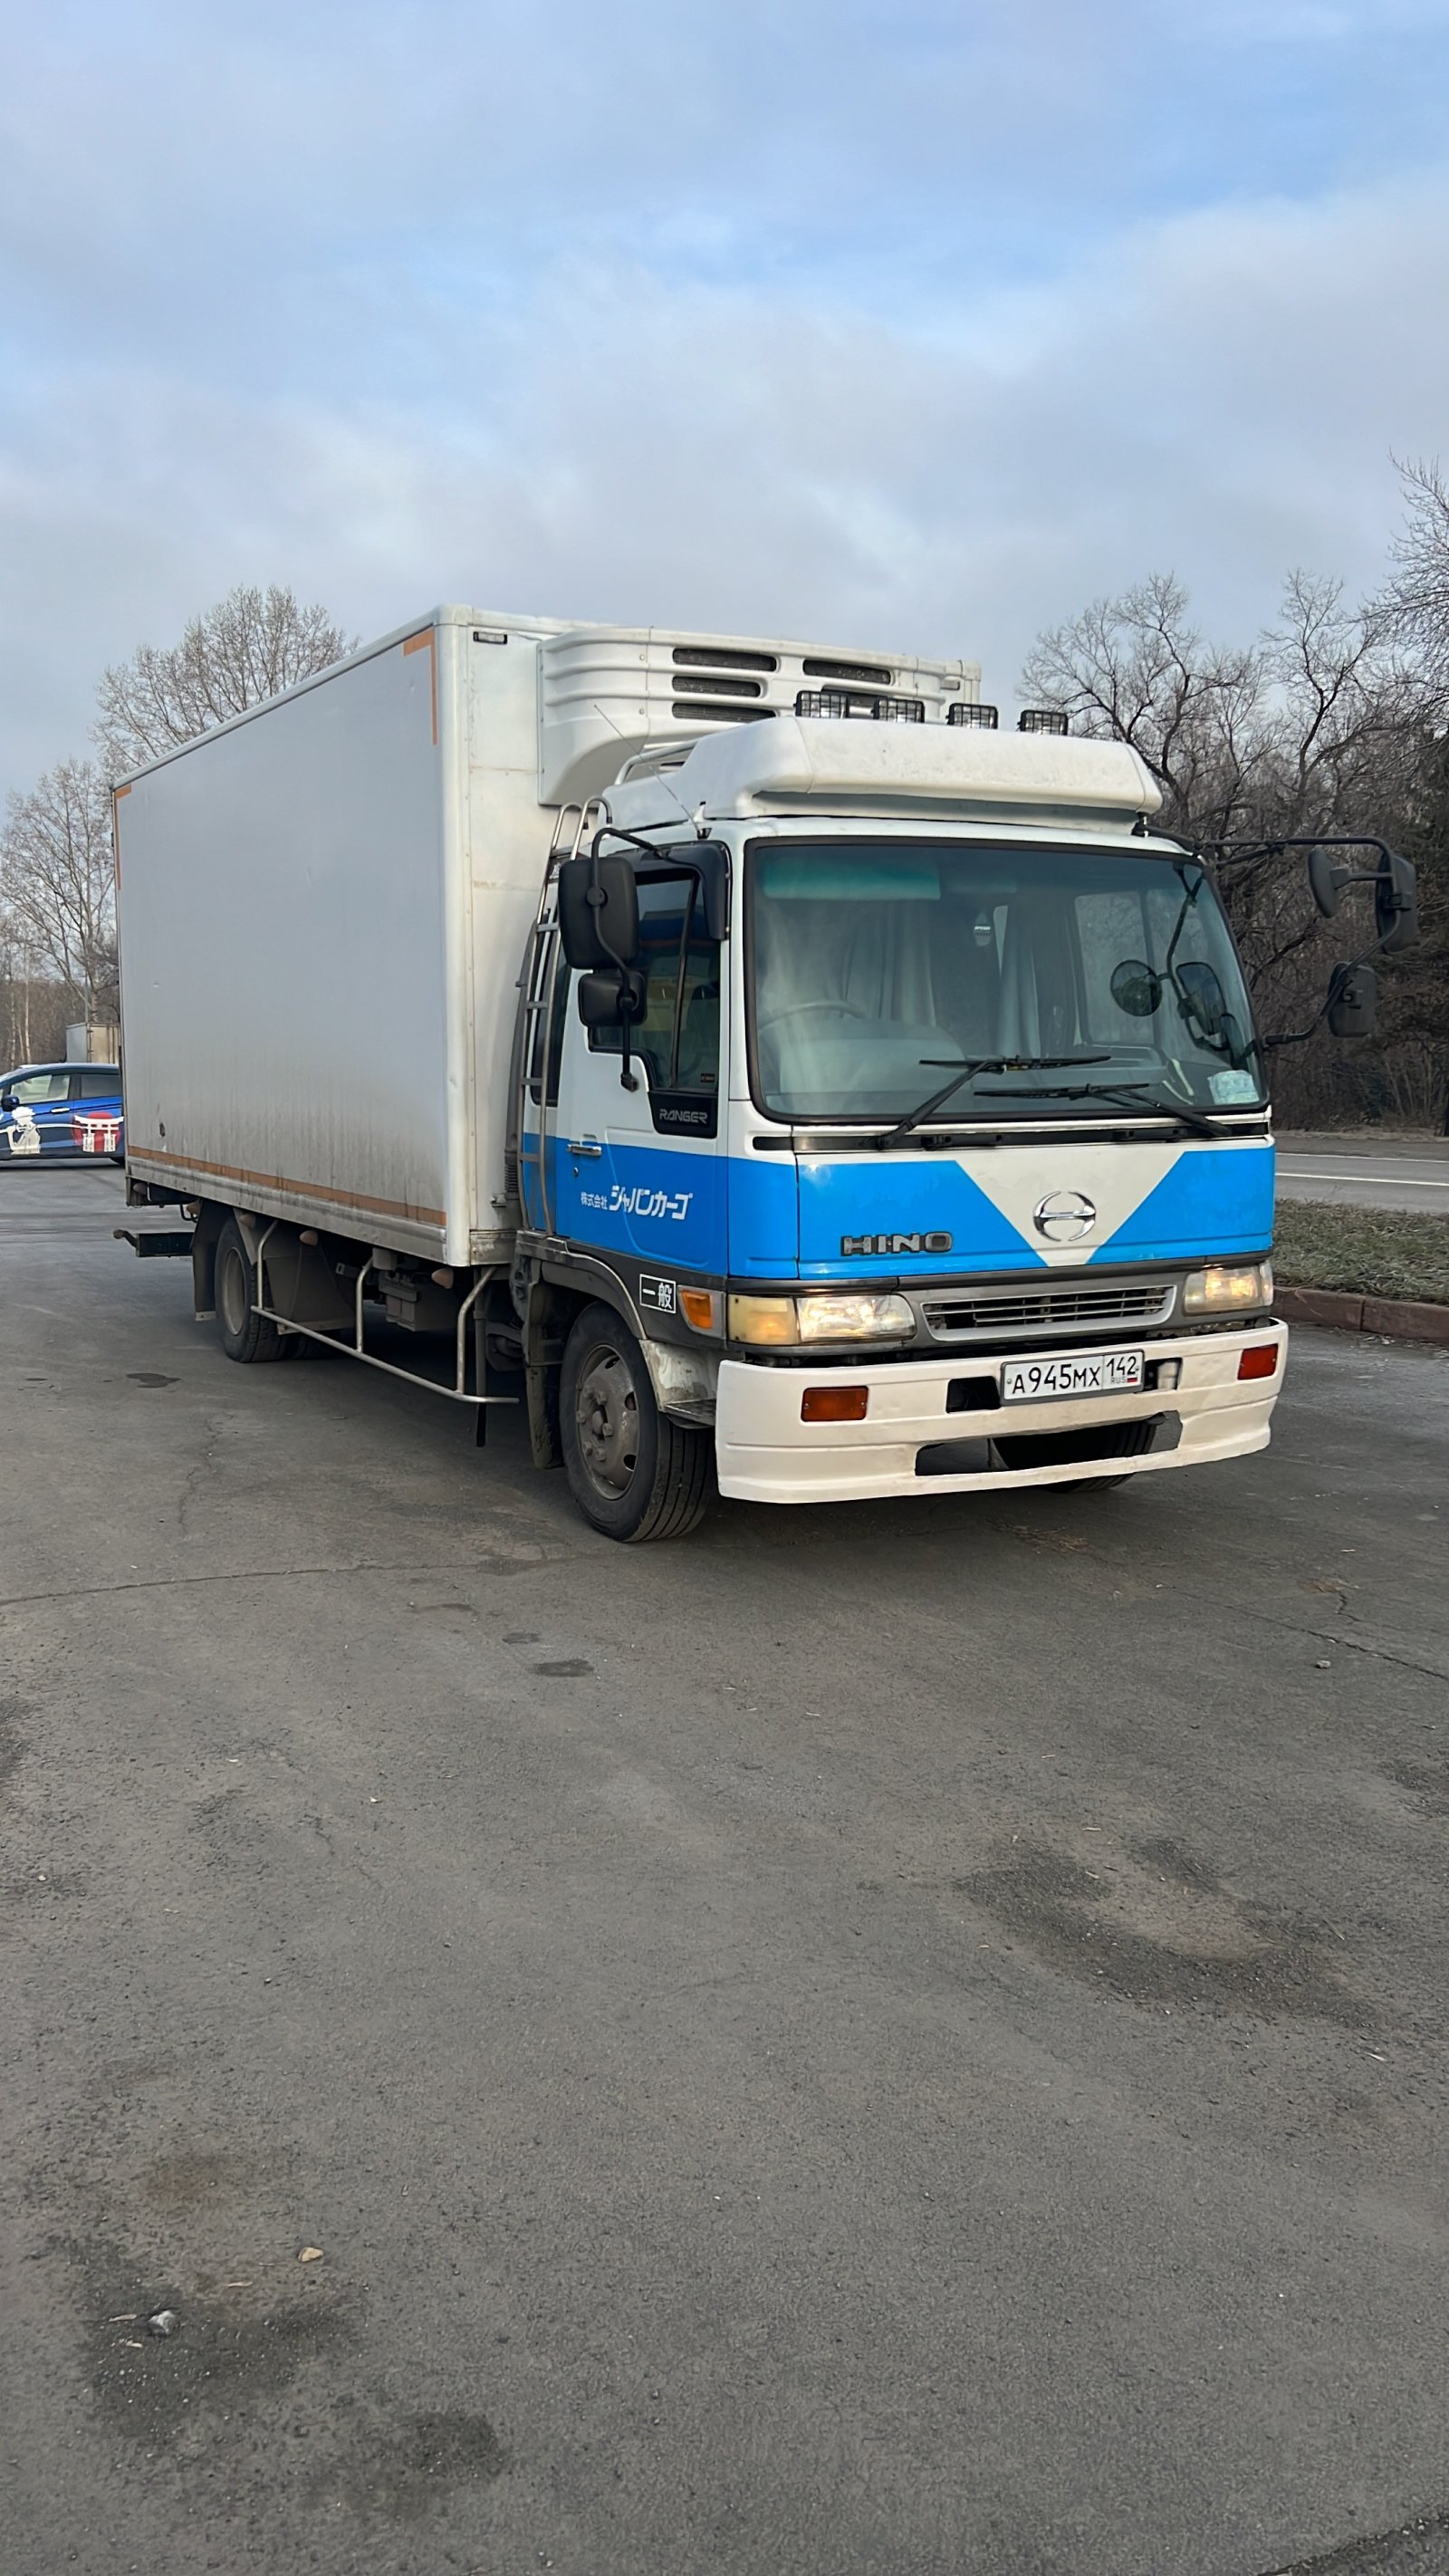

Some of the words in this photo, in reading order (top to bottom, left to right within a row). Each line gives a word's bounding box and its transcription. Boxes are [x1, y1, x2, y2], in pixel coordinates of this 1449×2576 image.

[659, 1109, 708, 1124] RANGER
[842, 1232, 953, 1256] HINO
[642, 1282, 673, 1310] 一般
[1107, 1356, 1137, 1378] 142
[1110, 1374, 1127, 1385] RUS
